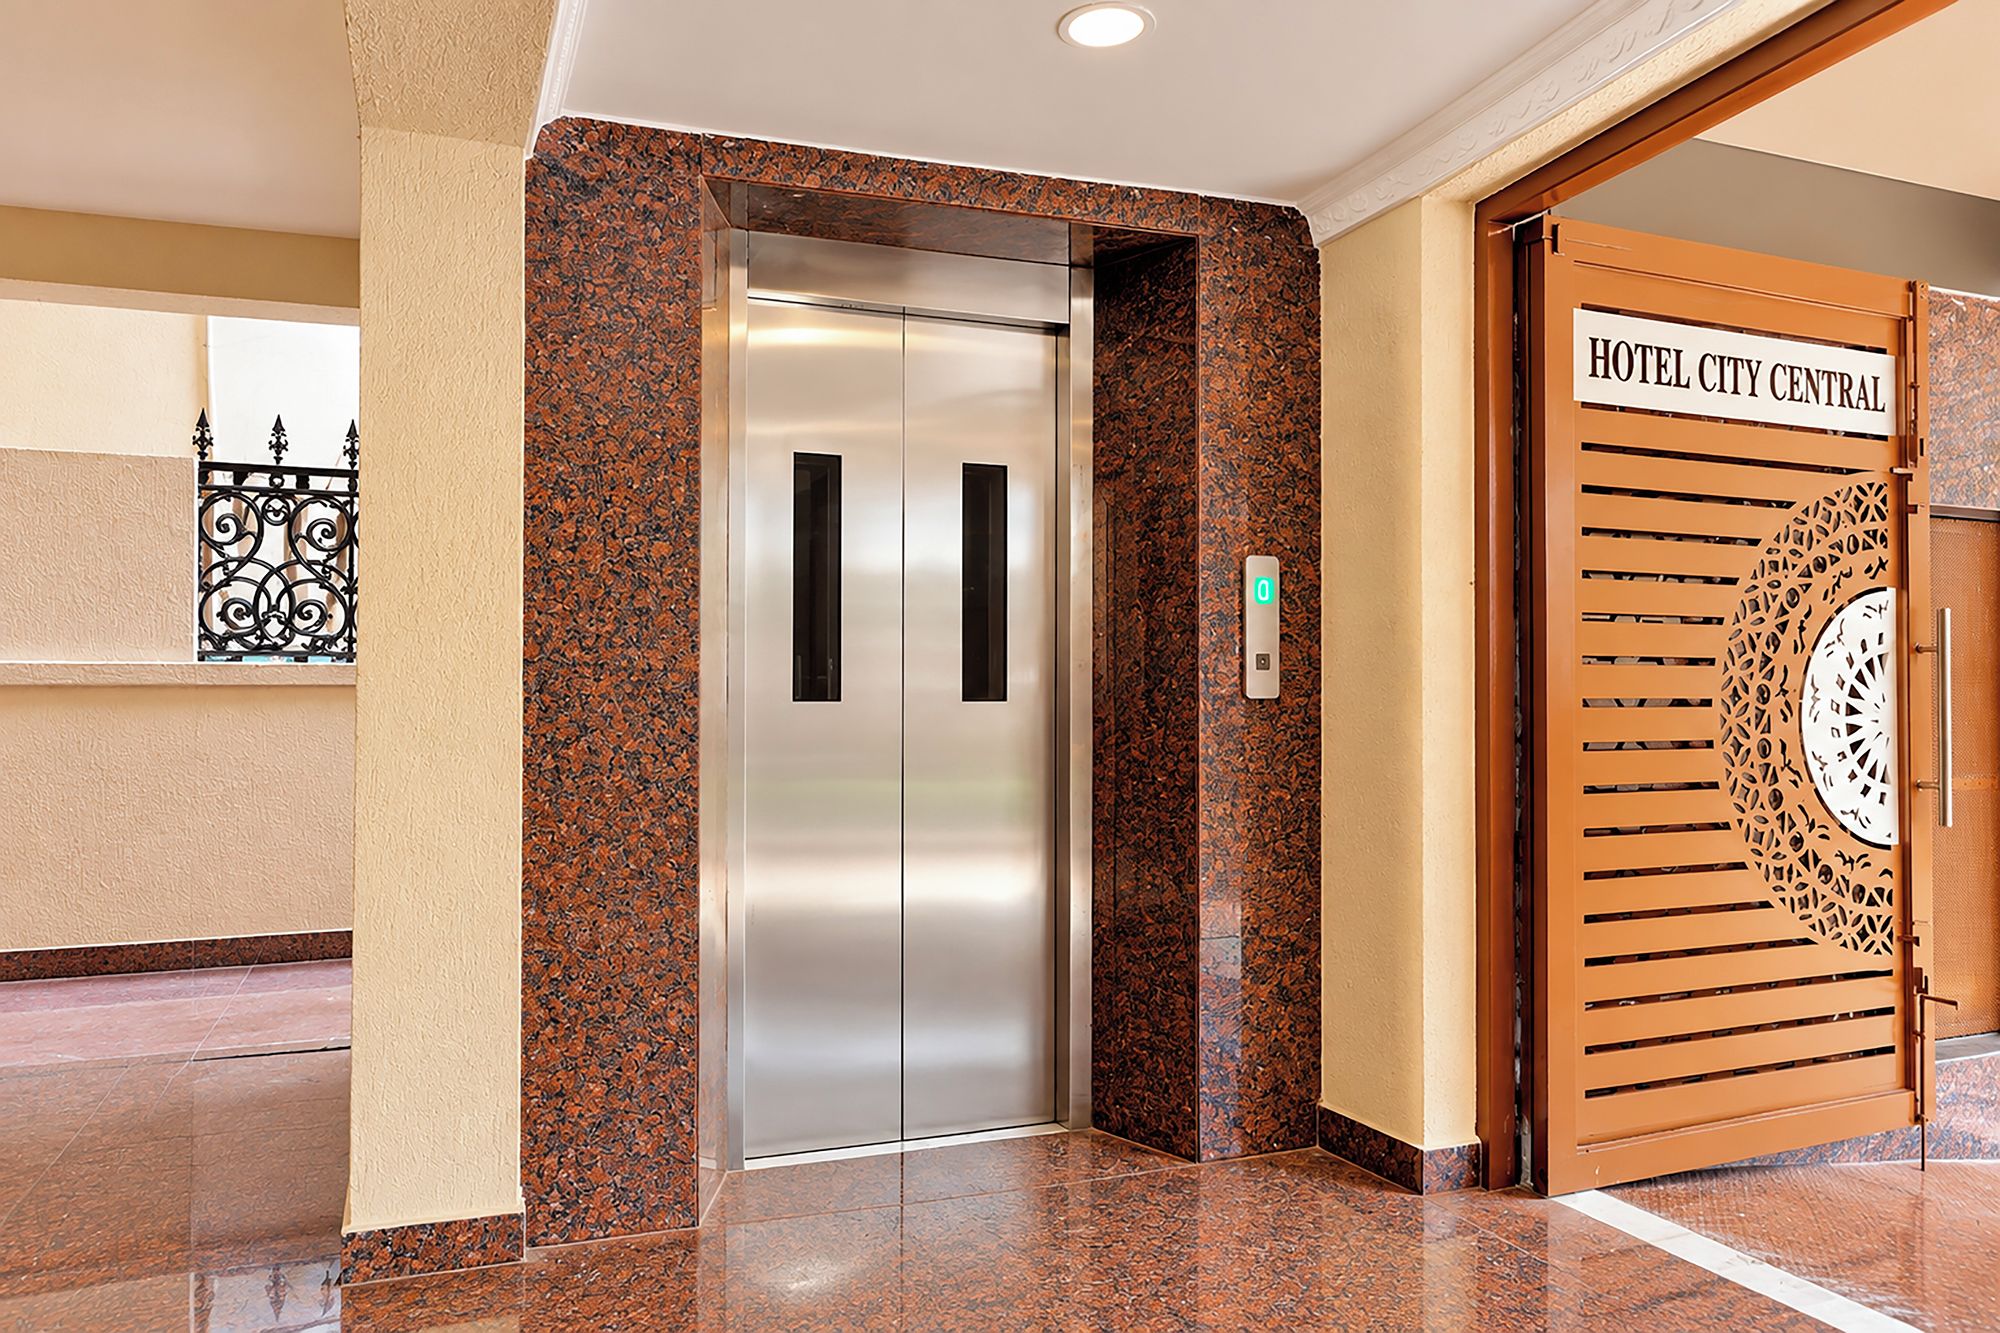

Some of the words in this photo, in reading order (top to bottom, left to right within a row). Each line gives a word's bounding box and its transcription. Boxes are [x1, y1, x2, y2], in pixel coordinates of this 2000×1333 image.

[1588, 336, 1690, 389] HOTEL
[1699, 352, 1762, 397] CITY
[1770, 362, 1886, 413] CENTRAL
[1257, 579, 1270, 601] 0
